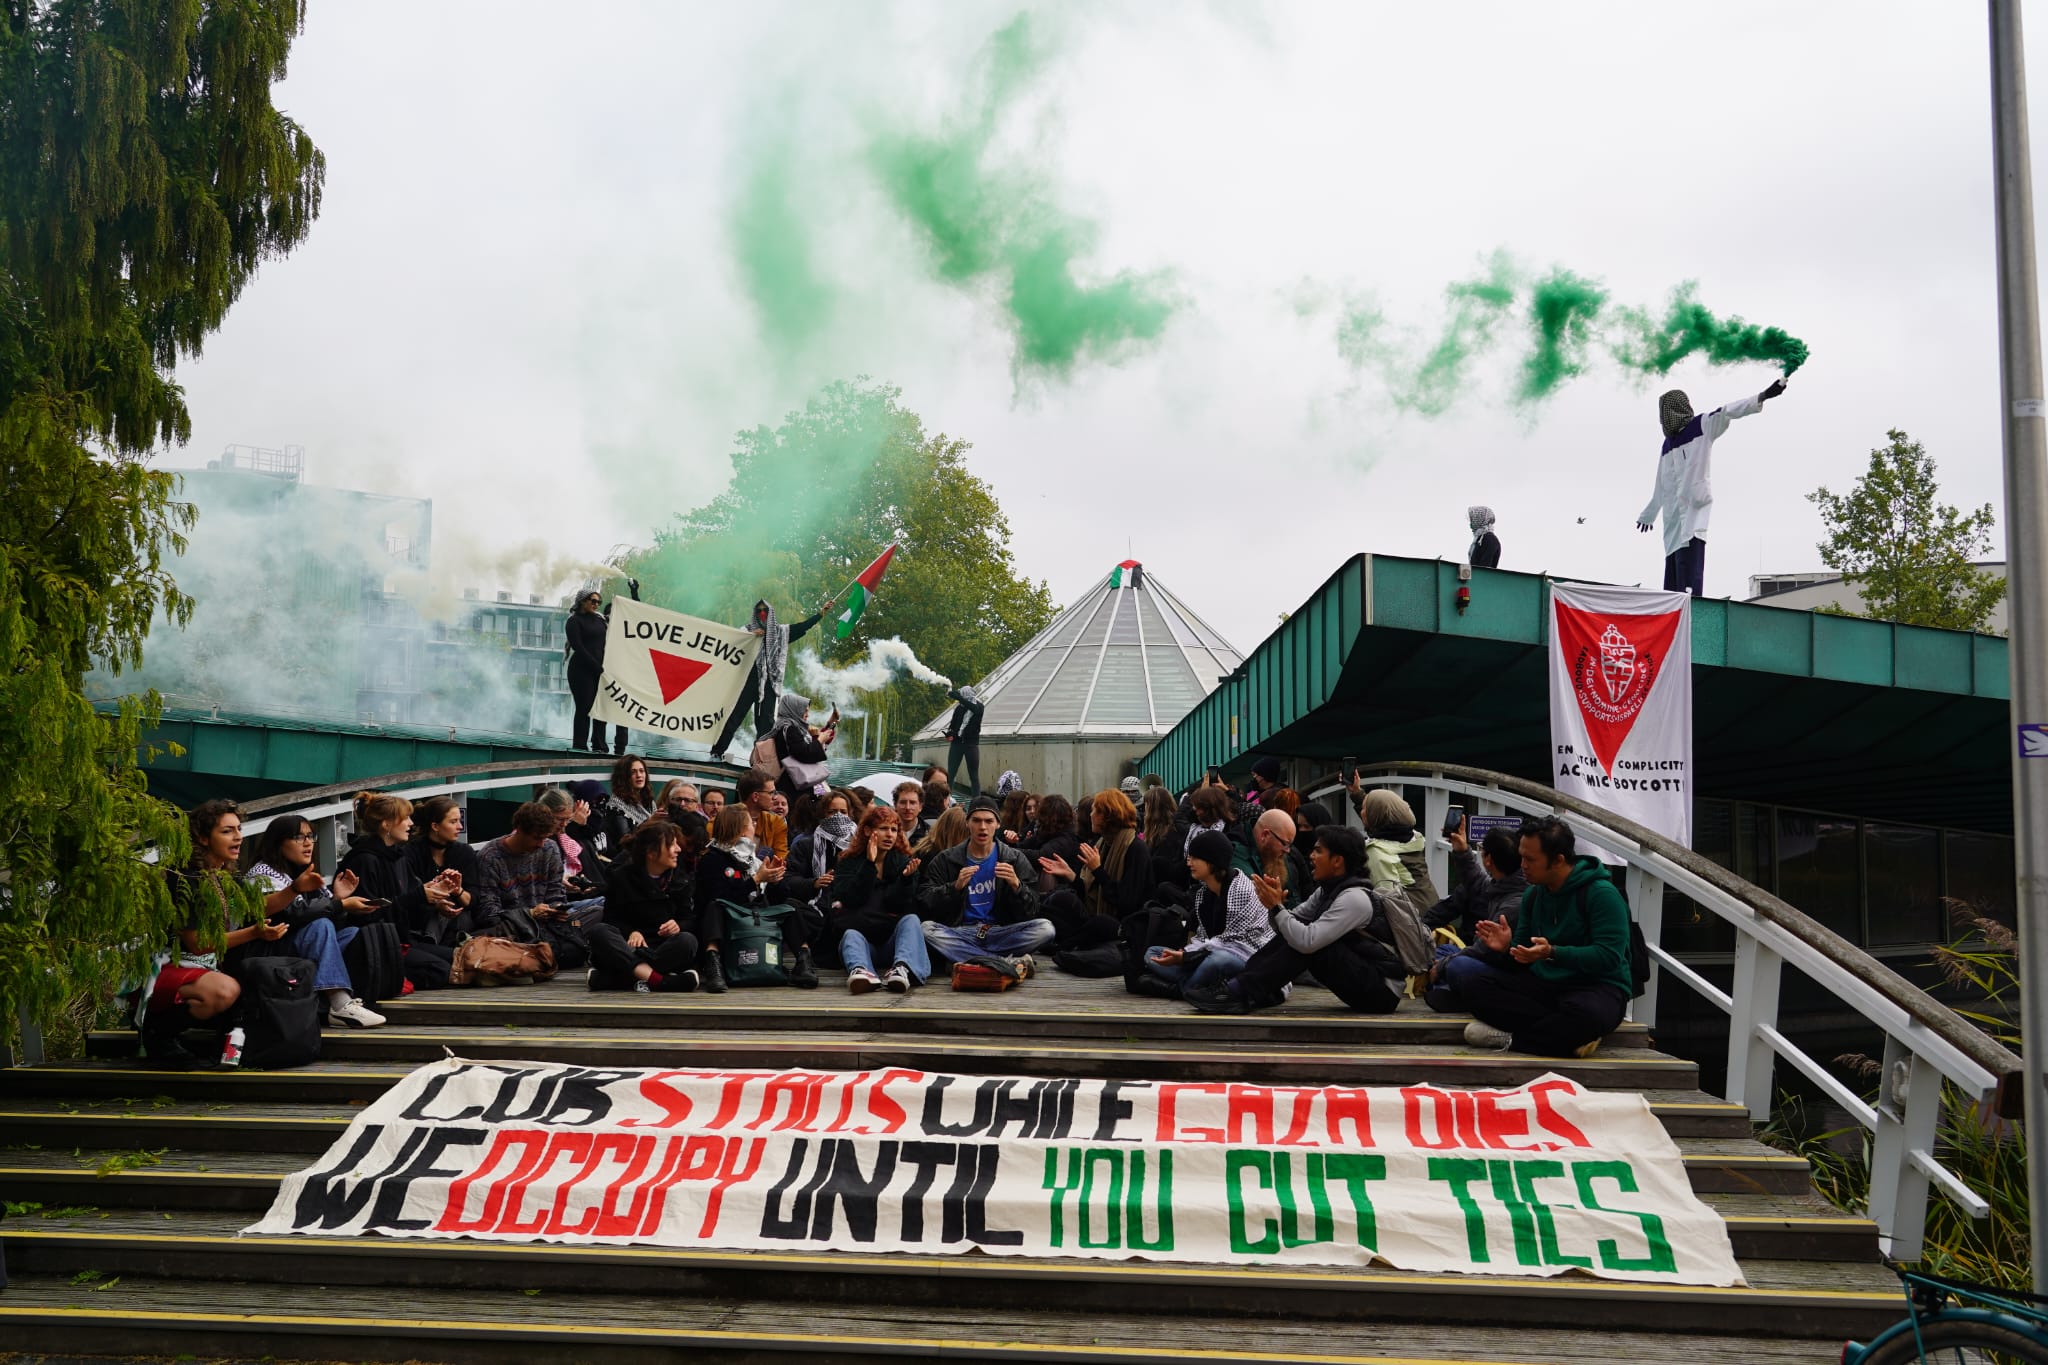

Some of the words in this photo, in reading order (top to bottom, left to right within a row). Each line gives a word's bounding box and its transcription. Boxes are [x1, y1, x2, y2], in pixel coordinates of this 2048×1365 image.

[623, 620, 685, 645] LOVE
[687, 632, 746, 666] JEWS
[604, 680, 649, 722] HATE
[648, 707, 725, 732] ZIONISM
[1557, 744, 1574, 754] EN
[1577, 755, 1597, 767] TCH
[1617, 760, 1684, 771] COMPLICITY
[1559, 763, 1610, 788] ACMIC
[616, 1069, 925, 1135] STALLS
[919, 1075, 1152, 1141] WHILE
[1156, 1083, 1376, 1148] GAZA
[1400, 1080, 1592, 1151] DIES
[291, 1125, 488, 1230] WE
[432, 1129, 767, 1239] OCCUPY
[758, 1137, 1024, 1246] UNTIL
[1041, 1147, 1174, 1252] YOU
[1226, 1149, 1387, 1254] CUT
[1428, 1156, 1678, 1273] TIES
